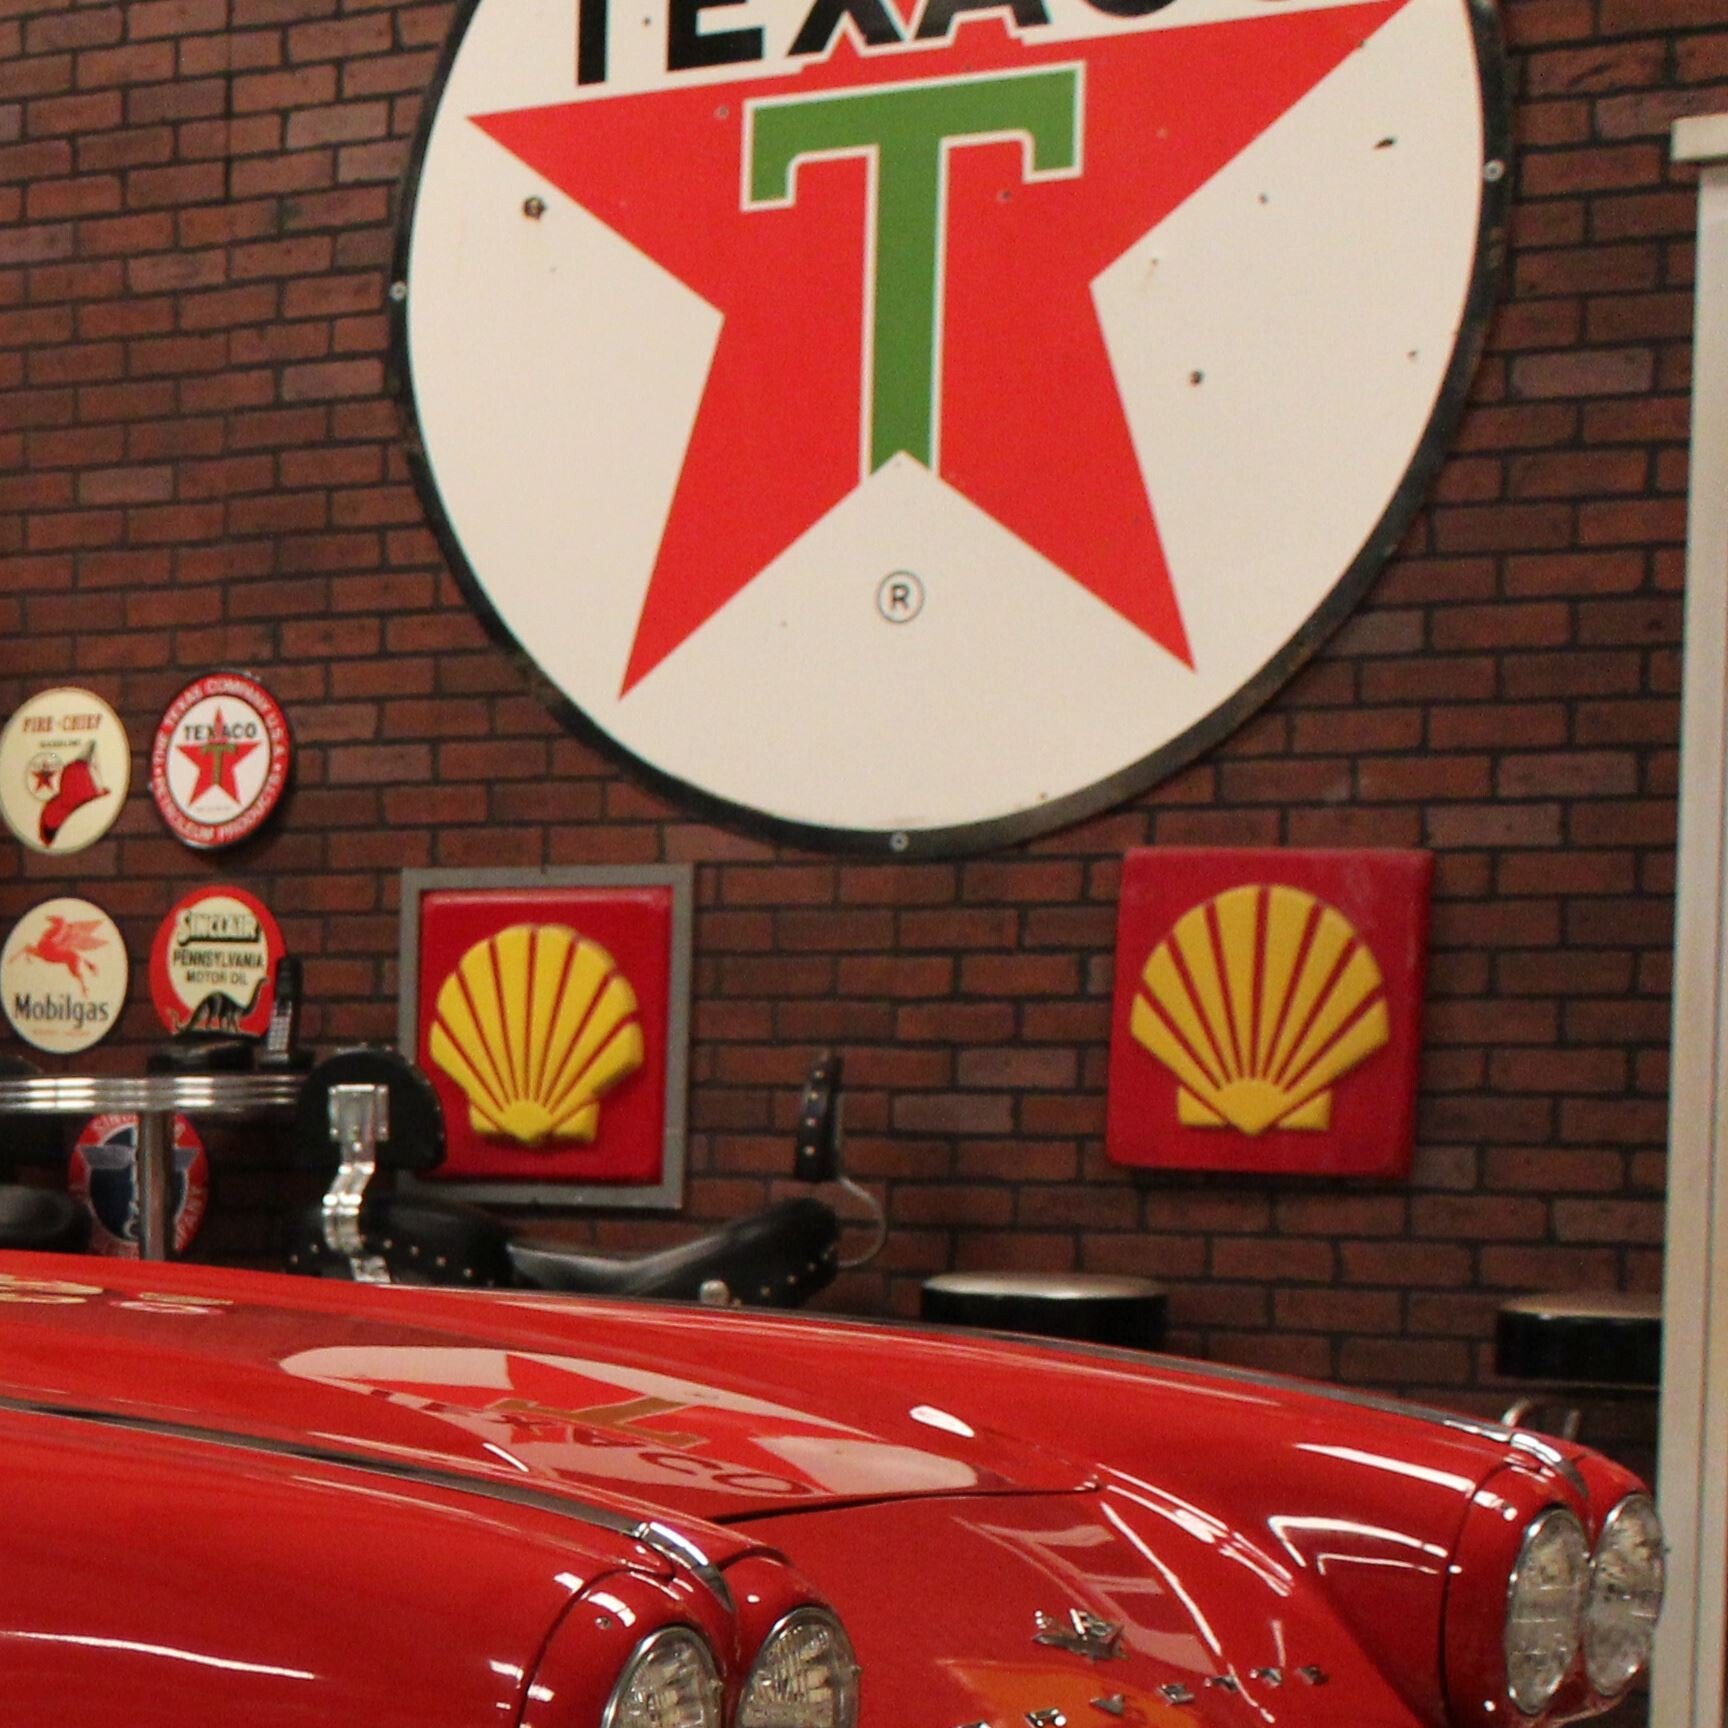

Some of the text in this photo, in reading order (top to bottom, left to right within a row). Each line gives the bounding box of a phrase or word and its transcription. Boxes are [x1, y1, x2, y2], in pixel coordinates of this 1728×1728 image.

[184, 723, 258, 740] TEXACO
[173, 949, 264, 969] PENNSYLVANIA
[186, 970, 249, 986] MOTOR OIL
[14, 992, 110, 1030] Mobilgas
